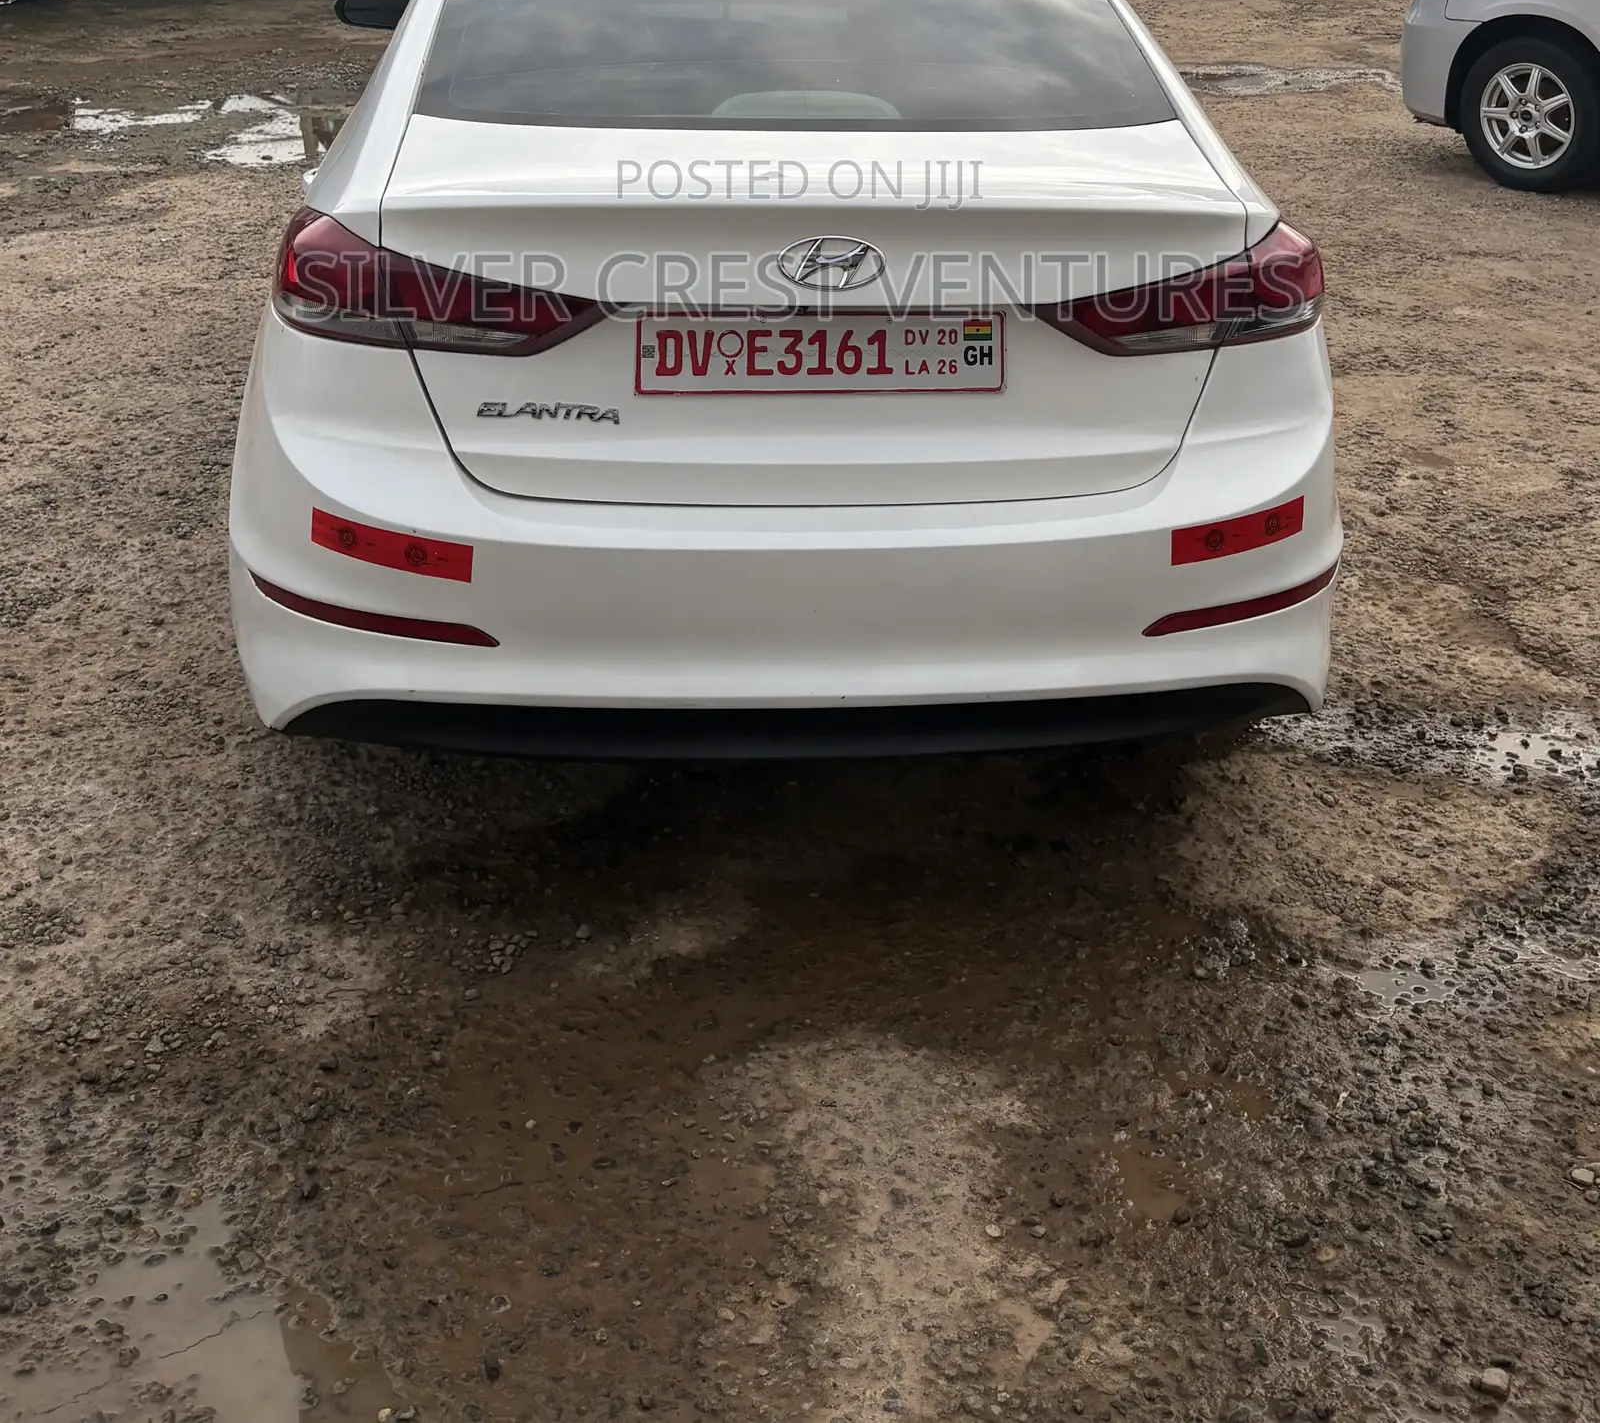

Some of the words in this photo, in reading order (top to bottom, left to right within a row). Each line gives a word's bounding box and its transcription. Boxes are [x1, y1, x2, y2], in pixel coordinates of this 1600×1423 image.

[904, 328, 931, 346] DV
[937, 328, 958, 346] 20
[655, 329, 715, 376] DV
[746, 329, 894, 375] E3161
[963, 345, 994, 366] GH
[904, 358, 931, 375] LA
[937, 359, 958, 375] 26
[476, 401, 621, 425] ELANTRA
